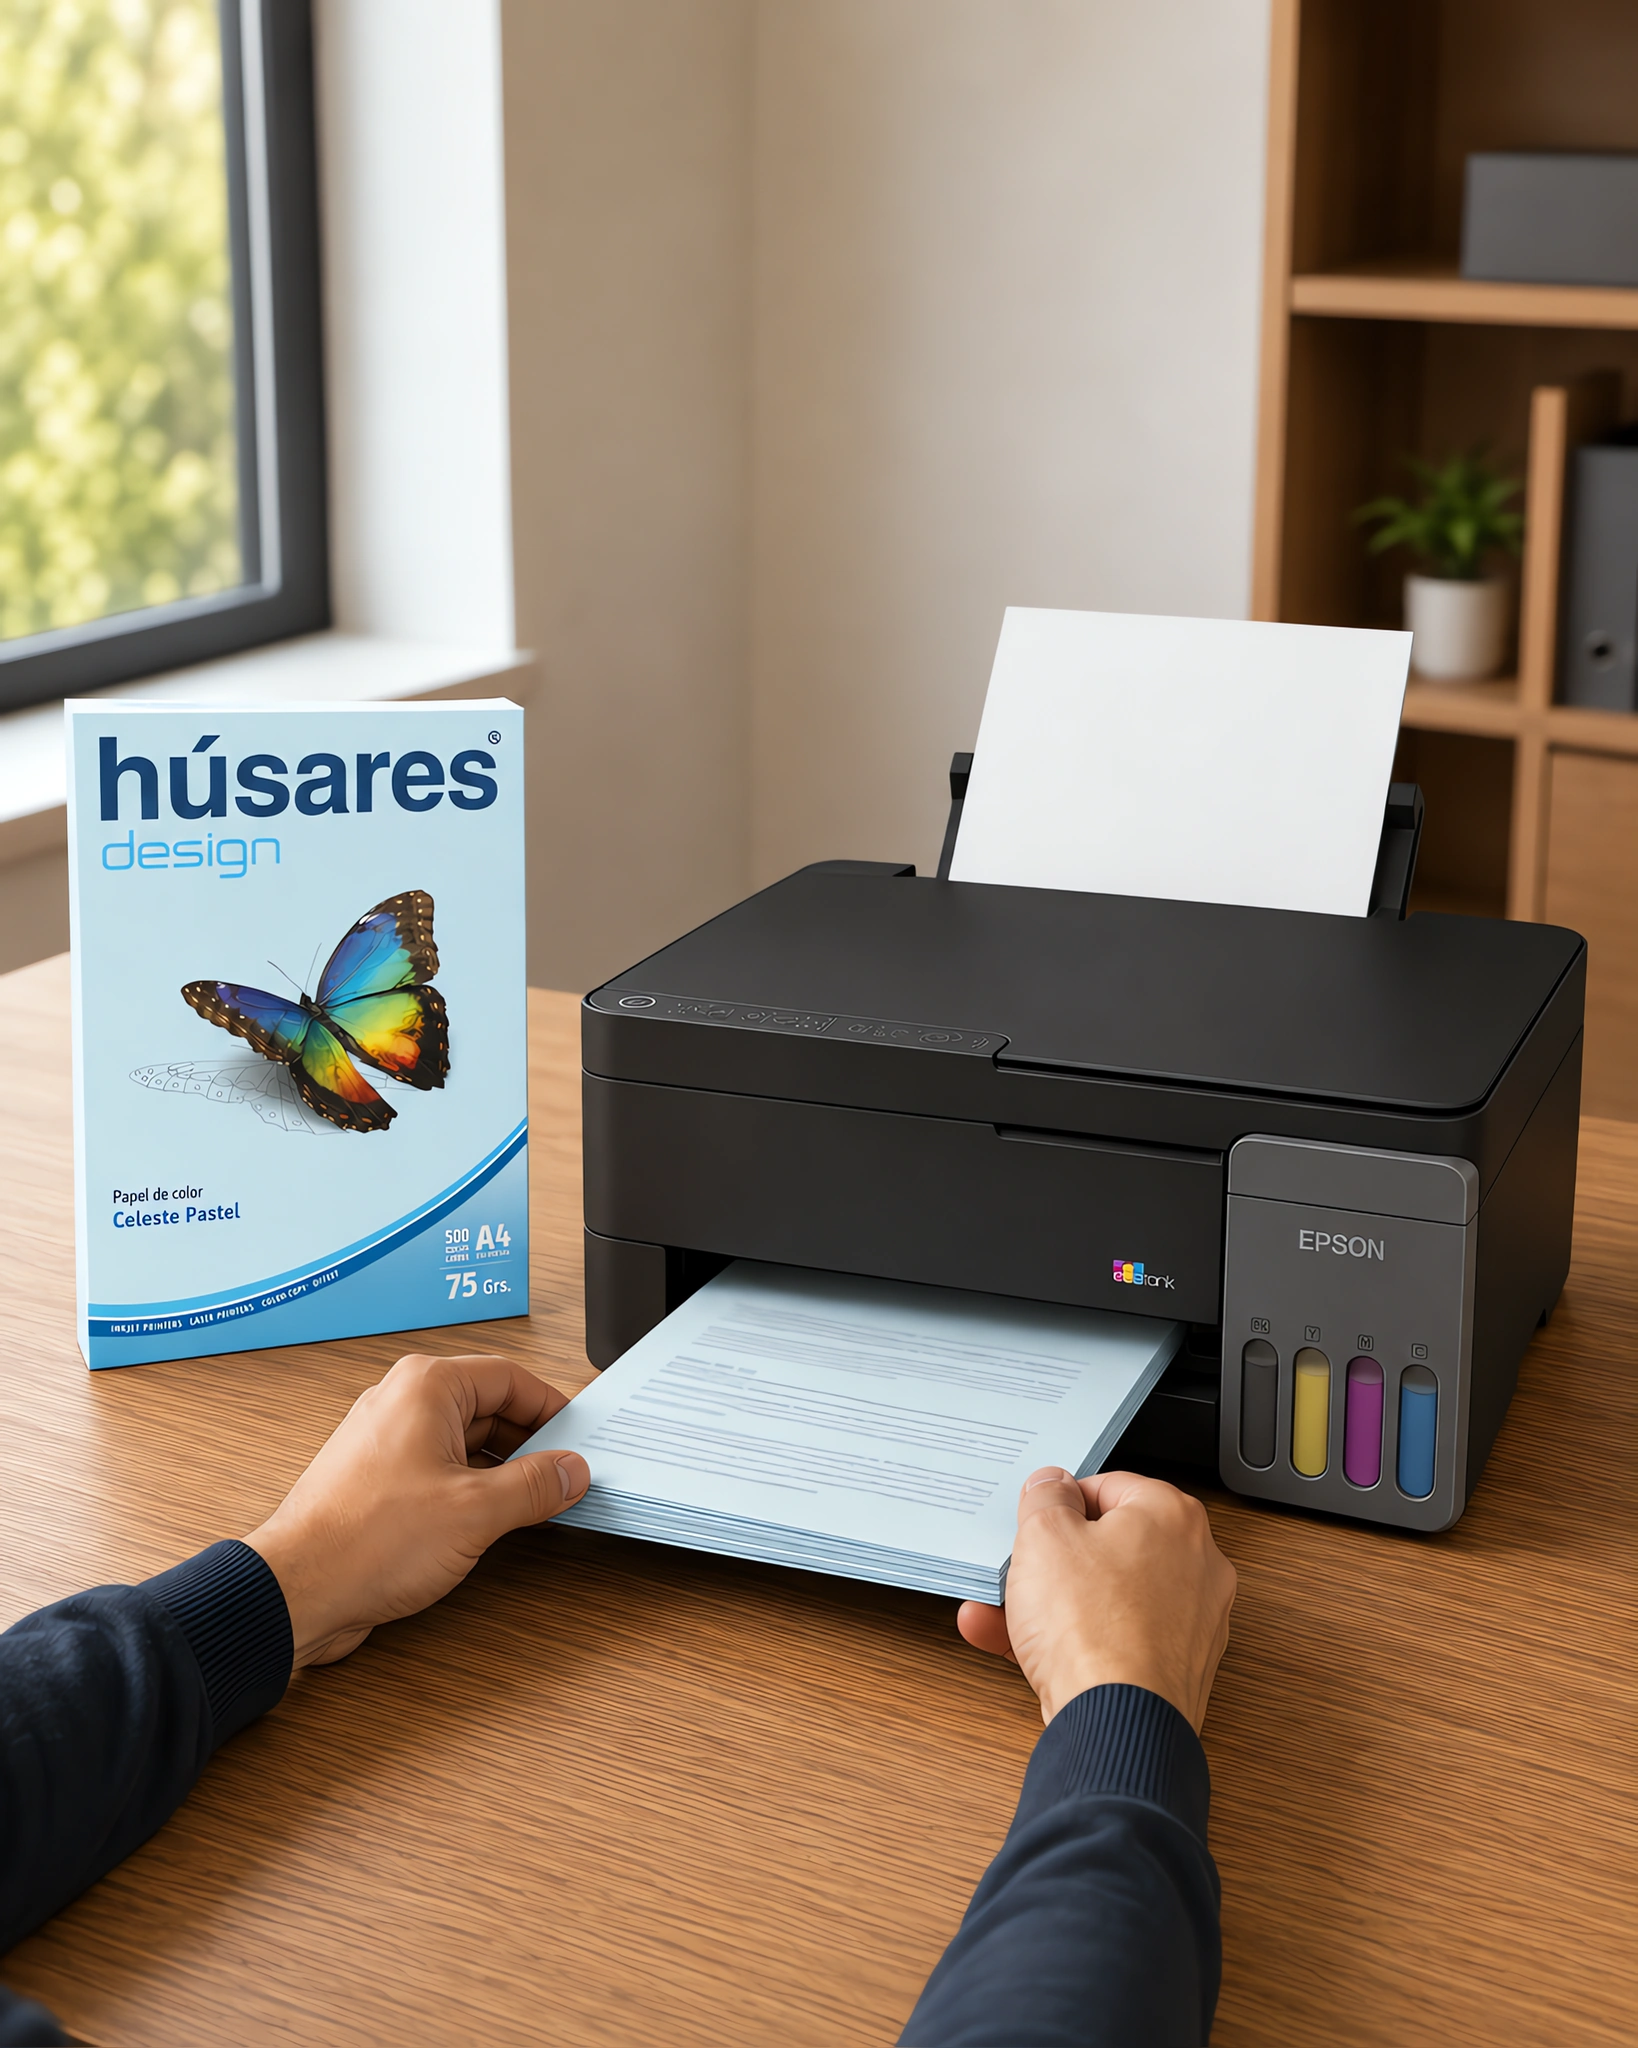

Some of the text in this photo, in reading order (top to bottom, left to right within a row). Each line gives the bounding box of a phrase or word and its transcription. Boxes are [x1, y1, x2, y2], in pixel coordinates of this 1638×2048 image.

[98, 734, 499, 821] húsares
[101, 829, 281, 879] design
[113, 1185, 203, 1206] Papel de color
[113, 1202, 241, 1228] Celeste Pastel
[445, 1228, 470, 1244] 500
[475, 1223, 512, 1251] A4
[1299, 1229, 1384, 1261] EPSON
[445, 1271, 512, 1300] 75 Grs.
